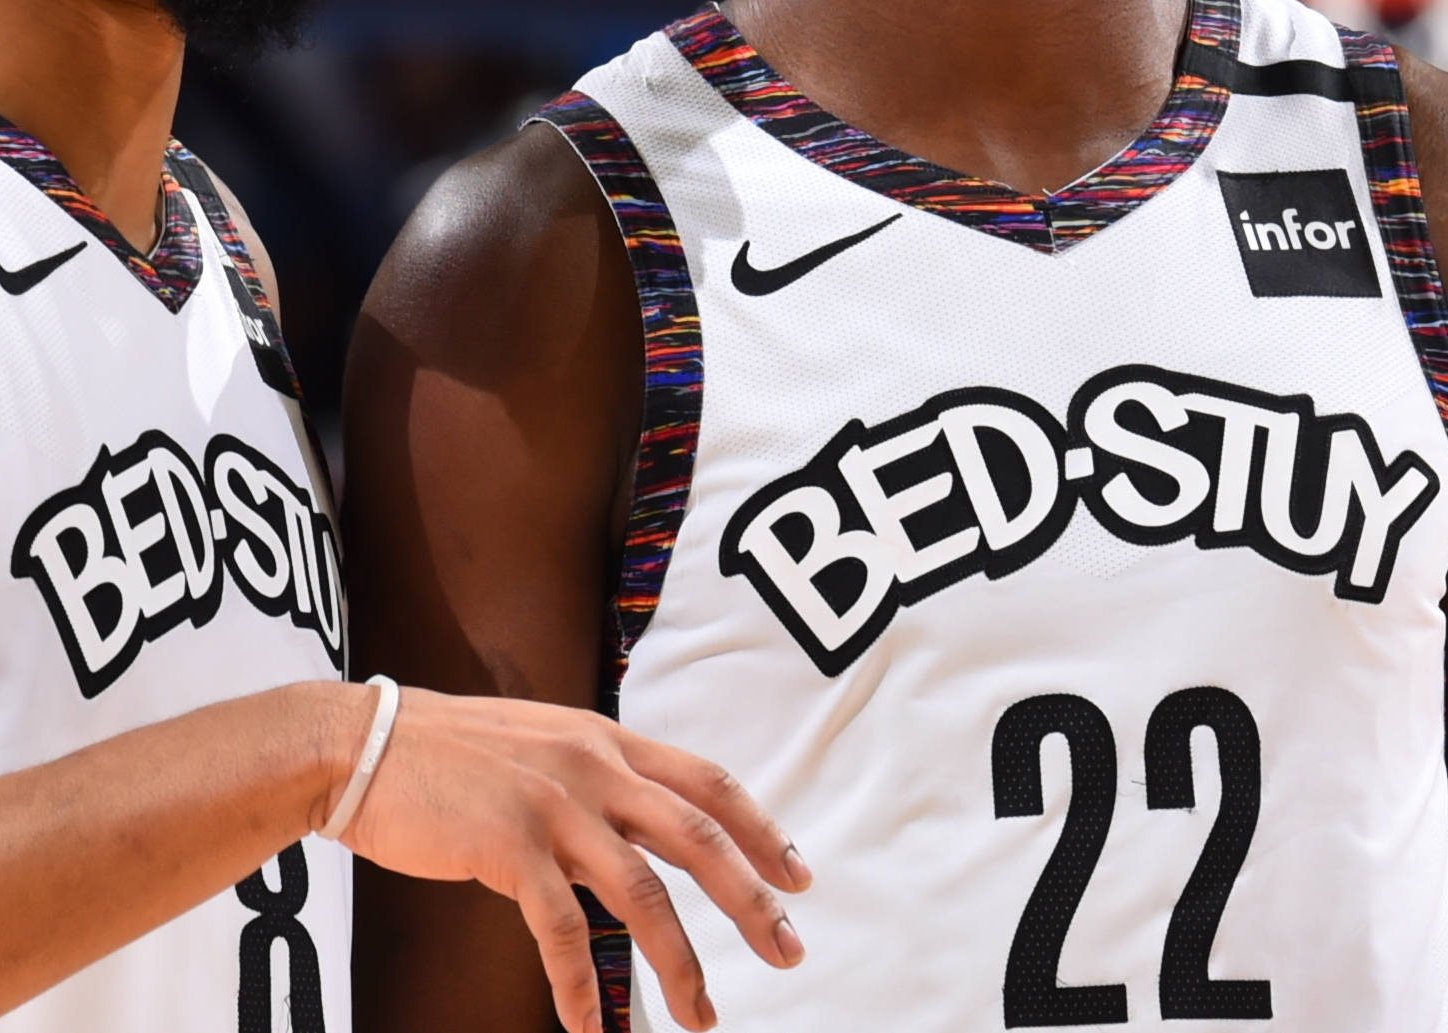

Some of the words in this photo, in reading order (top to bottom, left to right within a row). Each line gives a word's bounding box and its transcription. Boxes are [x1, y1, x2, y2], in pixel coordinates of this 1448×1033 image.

[1239, 207, 1357, 252] infor
[11, 429, 348, 699] BED-STU
[719, 364, 1440, 678] BED-STUY
[991, 686, 1273, 1029] 22
